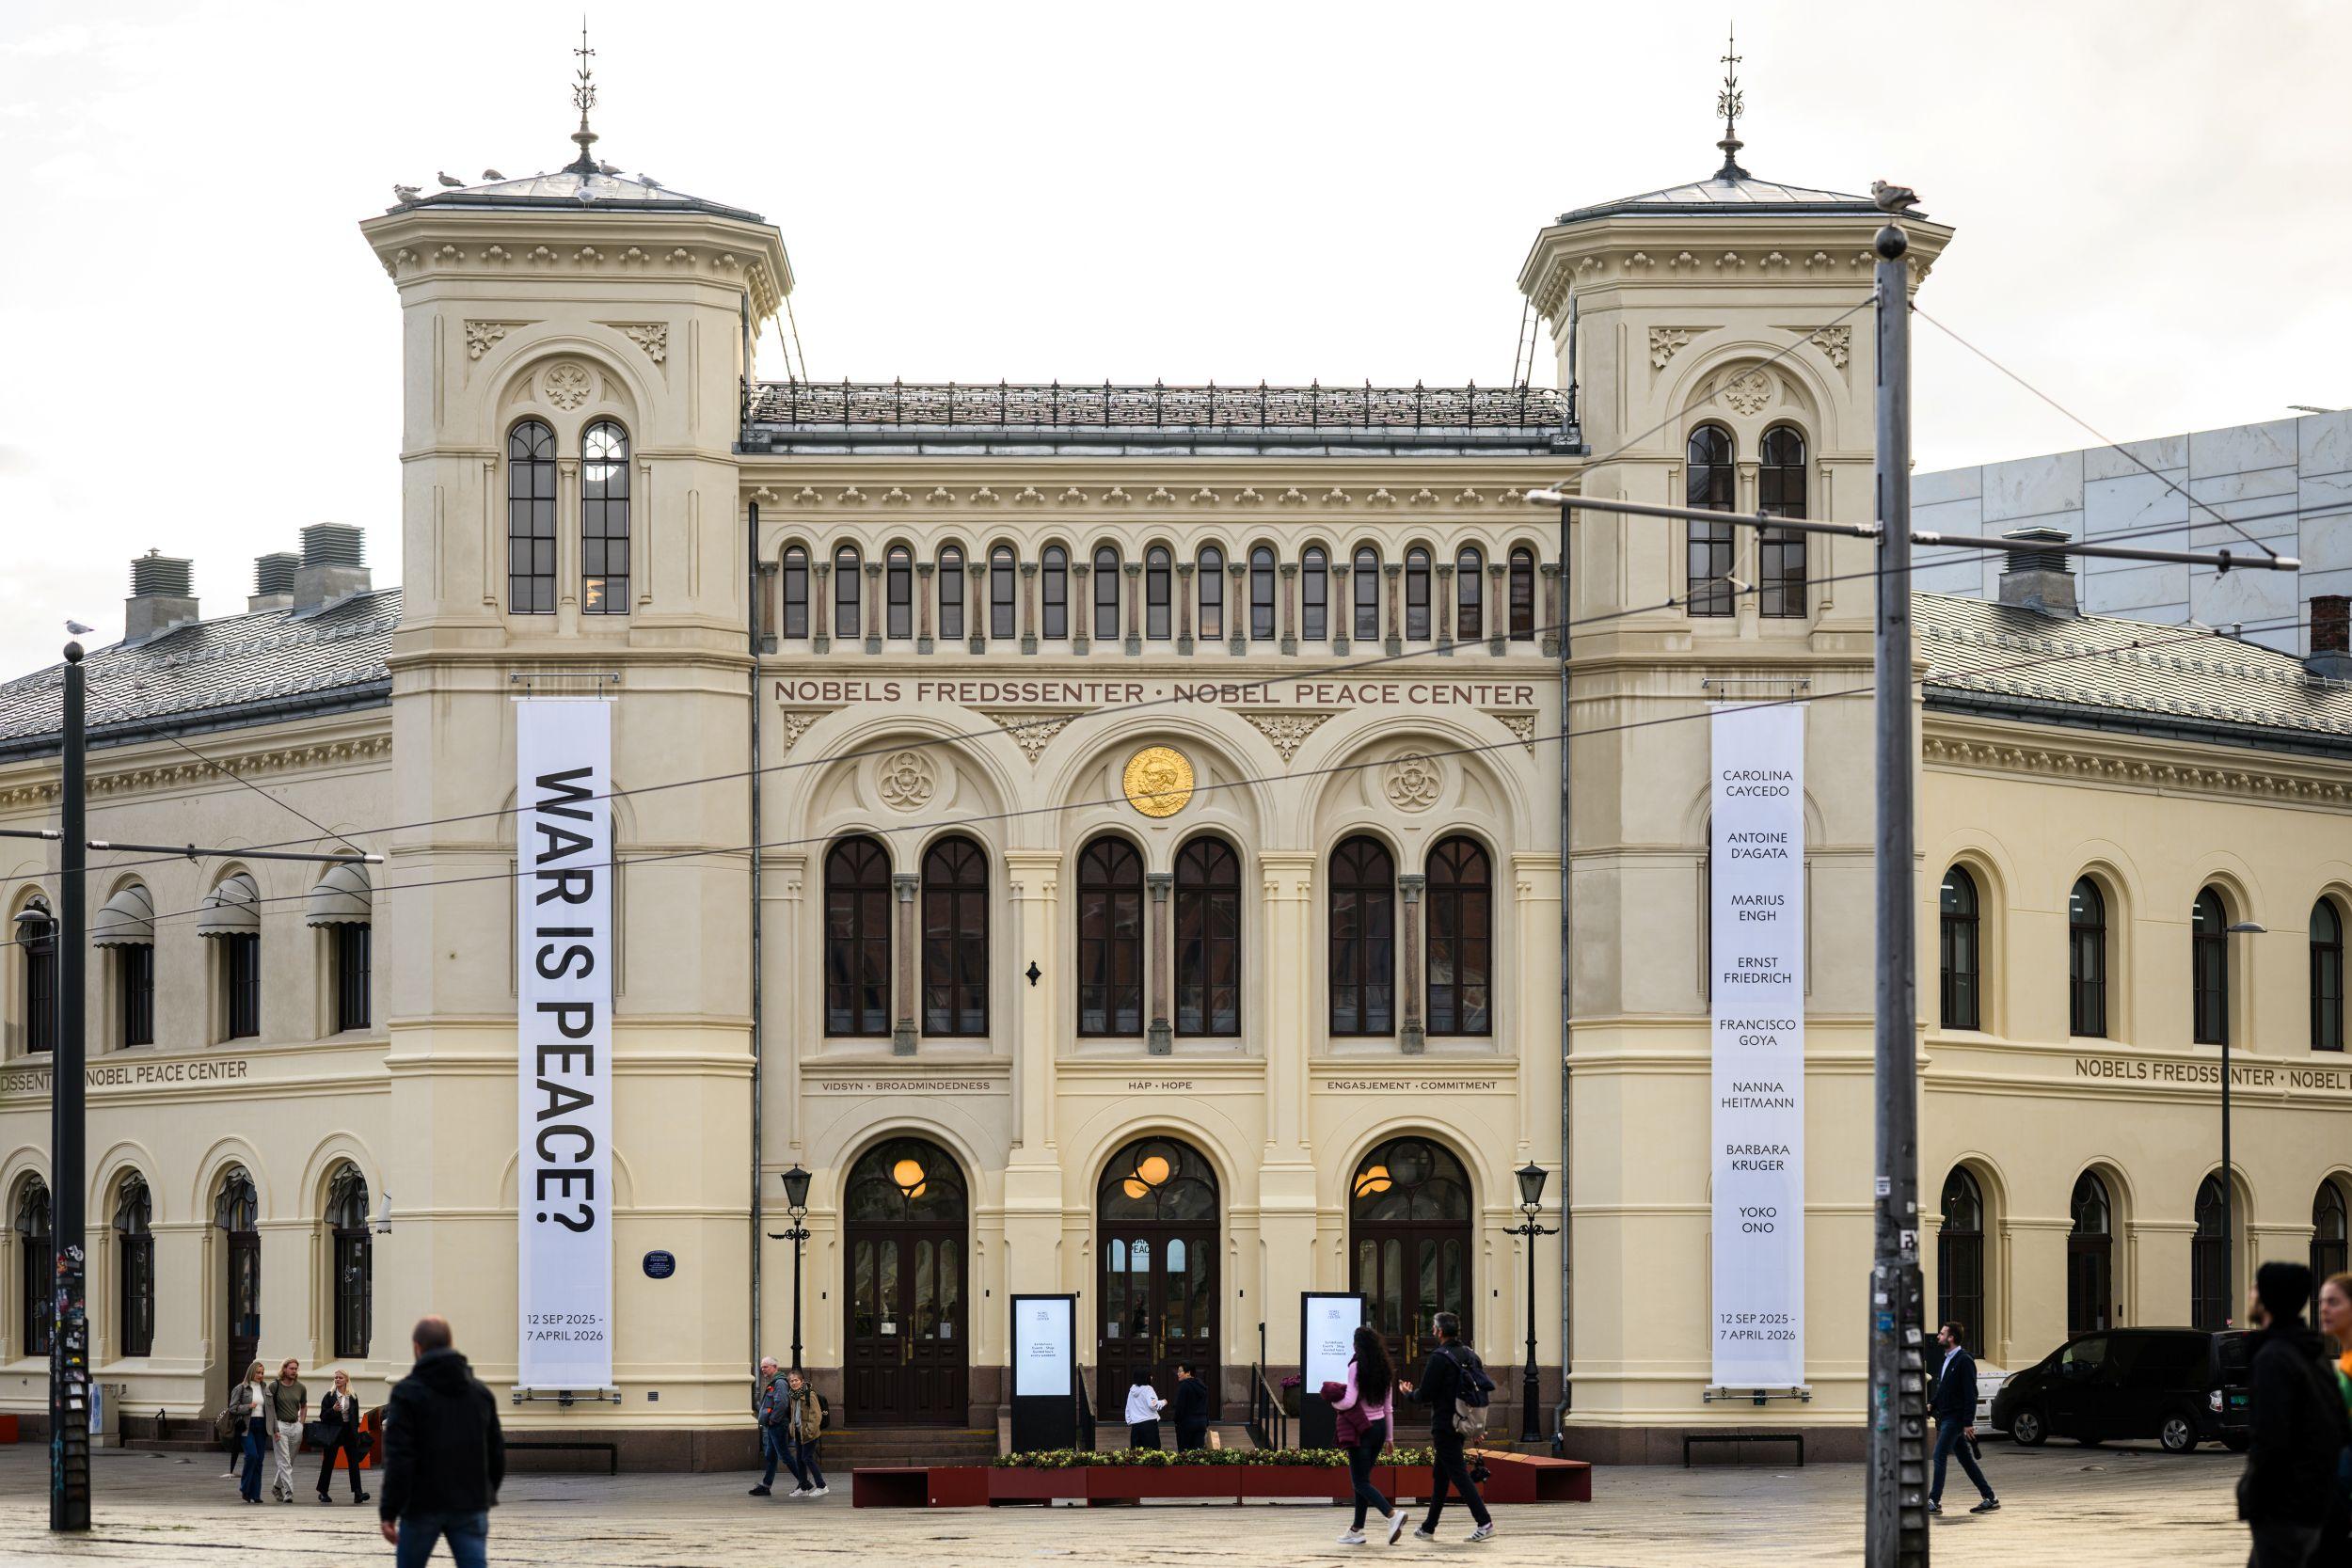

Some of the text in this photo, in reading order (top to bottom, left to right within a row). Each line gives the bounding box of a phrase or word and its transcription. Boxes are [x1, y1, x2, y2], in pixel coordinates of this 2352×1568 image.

[774, 681, 901, 702] NOBELS
[916, 682, 1145, 703] FREDSSENTER
[1173, 683, 1280, 704] NOBEL
[1295, 684, 1400, 704] PEACE
[1407, 685, 1534, 705] CENTER
[1723, 769, 1793, 781] CAROLINA
[1725, 785, 1789, 797] CAYCEDO
[1727, 832, 1788, 844] ANTOINE
[1731, 895, 1785, 906] MARIUS
[1739, 910, 1776, 922] ENGH
[1738, 957, 1778, 968] ERNST
[1724, 973, 1791, 984] FRIEDRICH
[535, 766, 596, 1233] WAR IS PEACE?
[1720, 1019, 1796, 1031] FRANCISCO
[1739, 1035, 1777, 1046] GOYA
[86, 1067, 133, 1087] NOBEL
[136, 1064, 184, 1085] PEACE
[188, 1061, 247, 1081] CENTER
[2075, 1058, 2147, 1080] NOBELS
[2153, 1063, 2275, 1086] FREDSSNTER
[2290, 1071, 2346, 1090] NOBEL
[822, 1082, 864, 1091] VIDSYN
[875, 1082, 991, 1091] BROADMINDEDNESS
[1161, 1081, 1194, 1090] HOPE
[1327, 1081, 1412, 1090] ENGASJEMENT
[1421, 1081, 1498, 1090] COMMITMENT
[1733, 1082, 1785, 1093] NANNA
[1722, 1097, 1794, 1108] HEITMANN
[1726, 1144, 1790, 1155] BARBARA
[1732, 1160, 1785, 1171] KRUGER
[1739, 1207, 1777, 1218] YOKO
[1741, 1222, 1774, 1234] ONO
[527, 1314, 539, 1324] 12
[542, 1314, 564, 1324] SEP
[565, 1314, 596, 1324] 2025
[1721, 1313, 1734, 1324] 12
[1736, 1313, 1757, 1324] SEP
[1759, 1313, 1788, 1324] 2025
[527, 1330, 604, 1341] 7 APRIL 2026
[1721, 1330, 1796, 1340] 7 APRIL 2026
